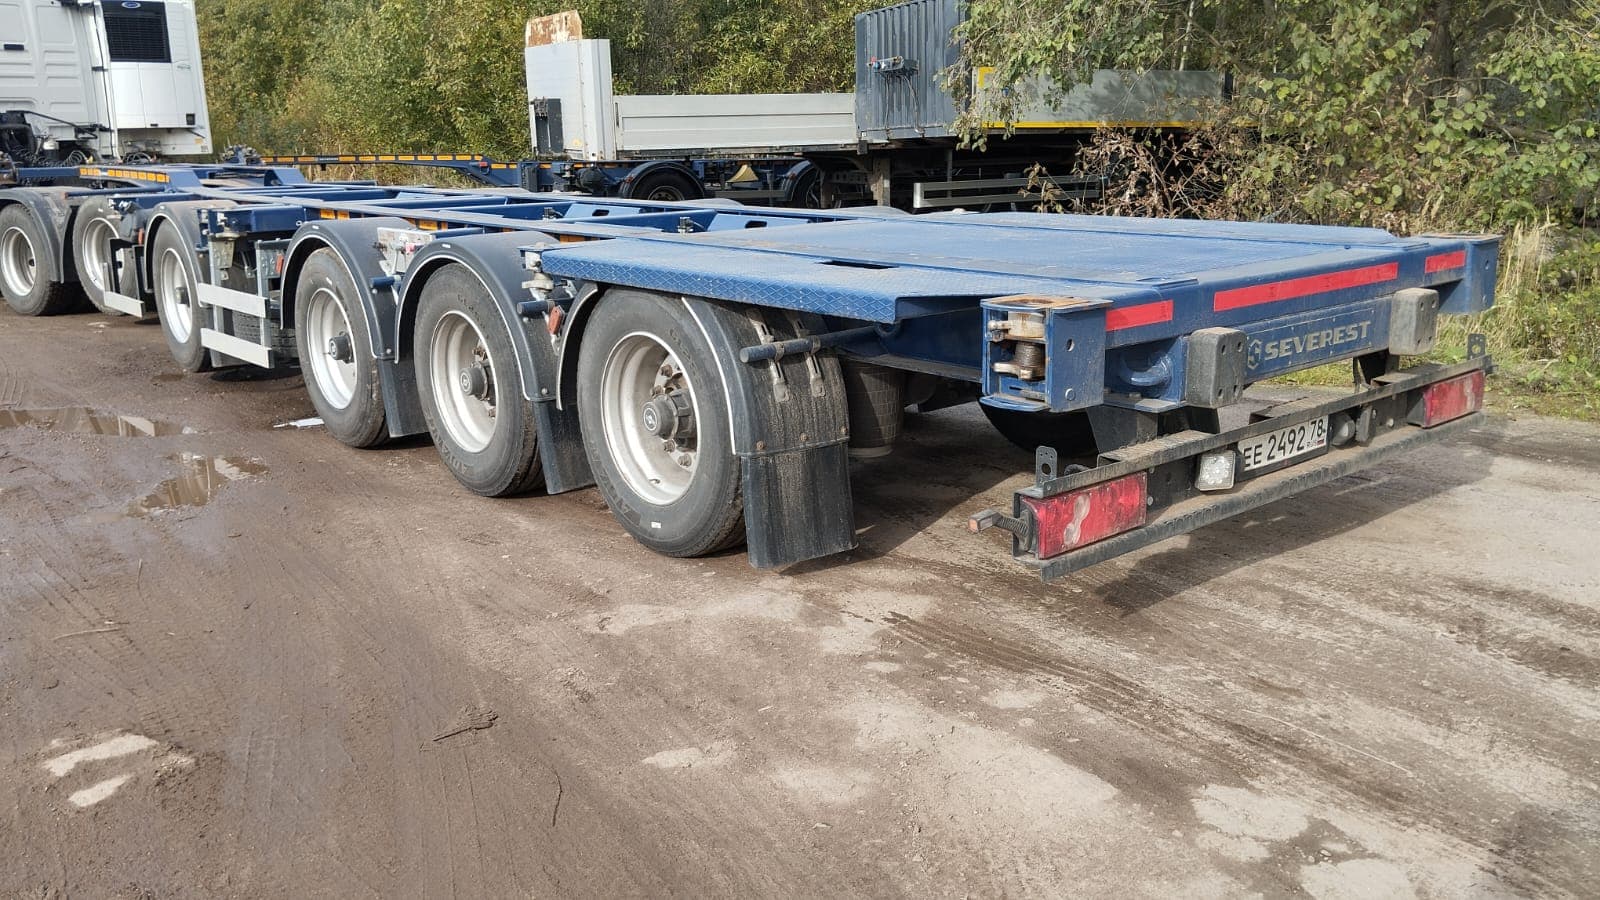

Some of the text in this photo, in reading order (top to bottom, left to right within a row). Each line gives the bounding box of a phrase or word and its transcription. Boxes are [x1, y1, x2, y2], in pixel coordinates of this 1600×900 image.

[1264, 321, 1371, 360] SEVEREST
[1267, 426, 1306, 461] 2492
[1310, 418, 1324, 440] 78
